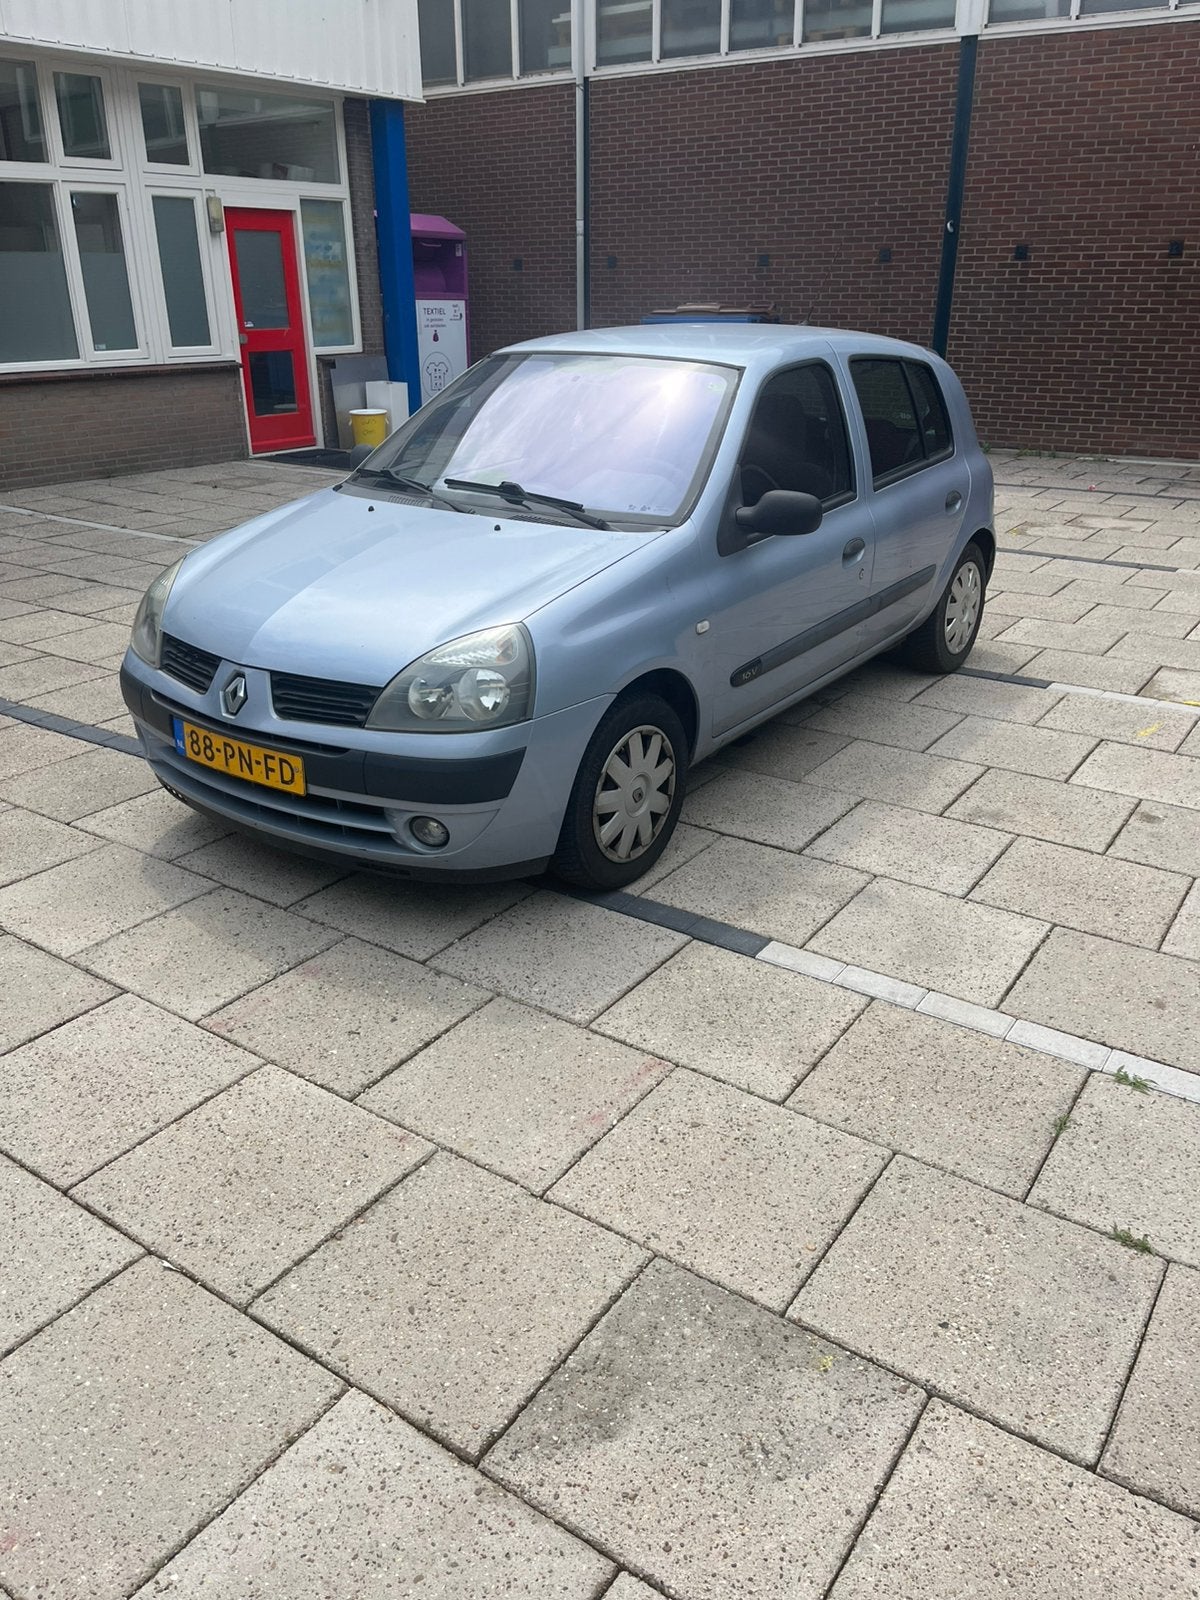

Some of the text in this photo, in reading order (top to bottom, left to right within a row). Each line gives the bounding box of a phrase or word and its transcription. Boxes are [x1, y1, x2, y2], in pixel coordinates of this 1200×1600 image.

[423, 307, 446, 315] TEXTIEL
[176, 739, 185, 749] NL
[190, 729, 295, 785] 88-PN-FD
